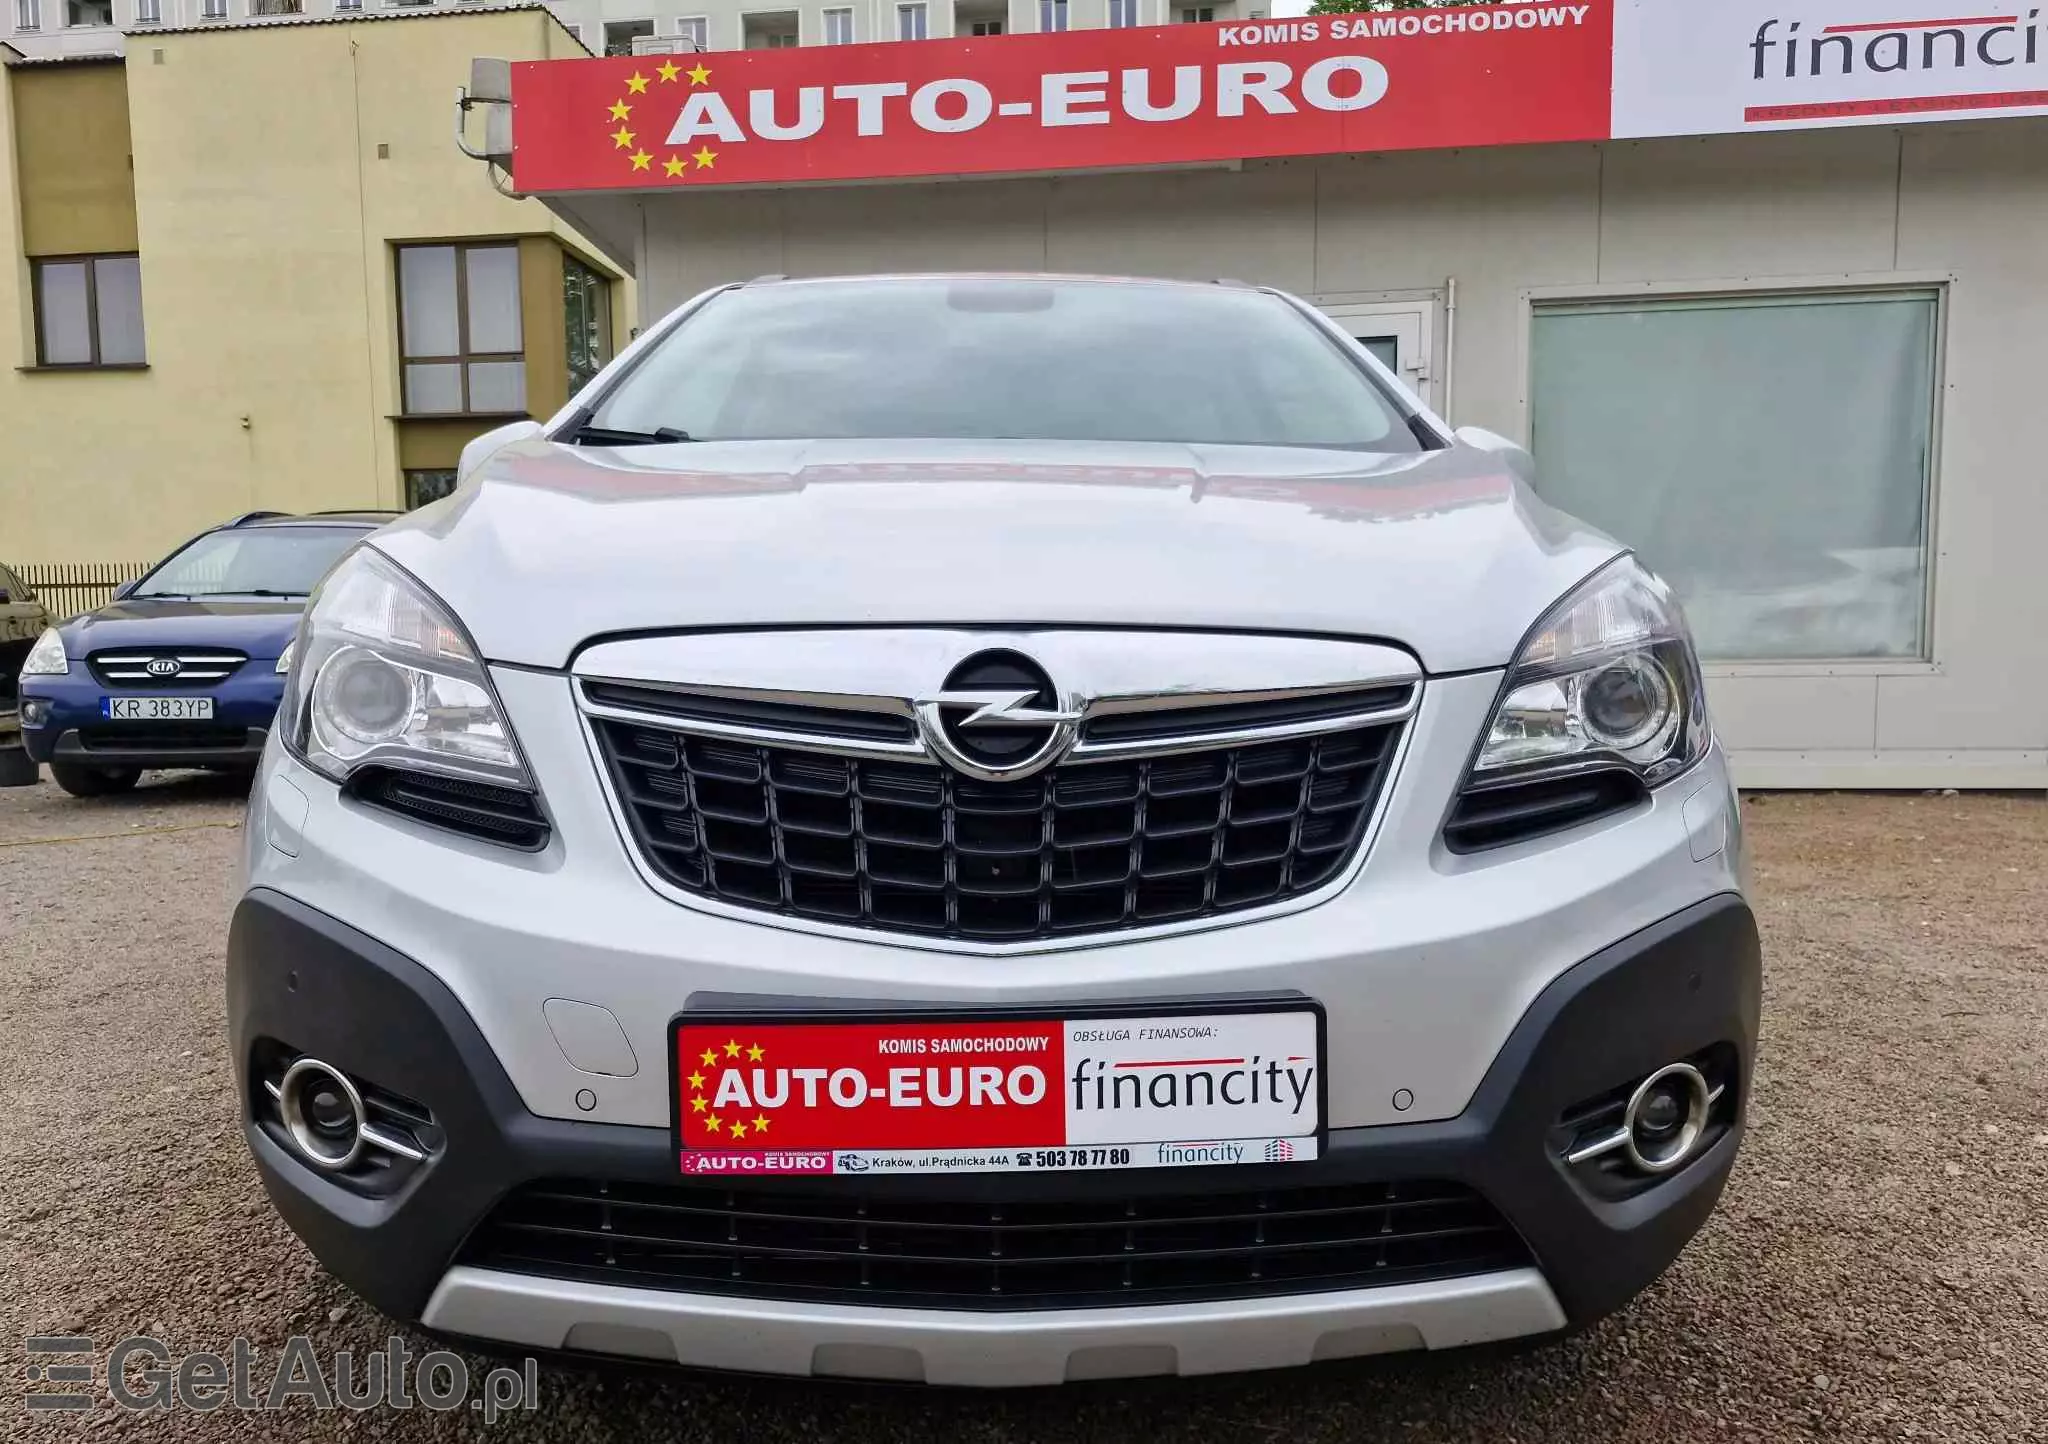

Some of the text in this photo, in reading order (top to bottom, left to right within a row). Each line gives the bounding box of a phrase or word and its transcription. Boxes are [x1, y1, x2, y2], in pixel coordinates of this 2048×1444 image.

[1218, 5, 1590, 46] KOMIS SAMOCHODOWY
[1749, 8, 2048, 80] financi
[664, 56, 1389, 145] AUTO-EURO
[152, 662, 175, 672] KIA
[113, 700, 209, 718] KR 383YP
[1073, 1027, 1219, 1042] OBSŁUGA FINANSOWA:
[878, 1037, 1049, 1054] KOMIS SAMOCHODOWY
[713, 1065, 1047, 1109] AUTO-EURO
[1072, 1056, 1314, 1114] financity
[696, 1156, 826, 1169] AUTO-EURO
[872, 1157, 916, 1168] Kraków,
[989, 1155, 1010, 1165] 44A
[1036, 1150, 1066, 1167] 503
[1070, 1150, 1088, 1166] 78
[1091, 1149, 1106, 1165] 77
[1110, 1149, 1130, 1164] 80
[1158, 1142, 1244, 1164] financity
